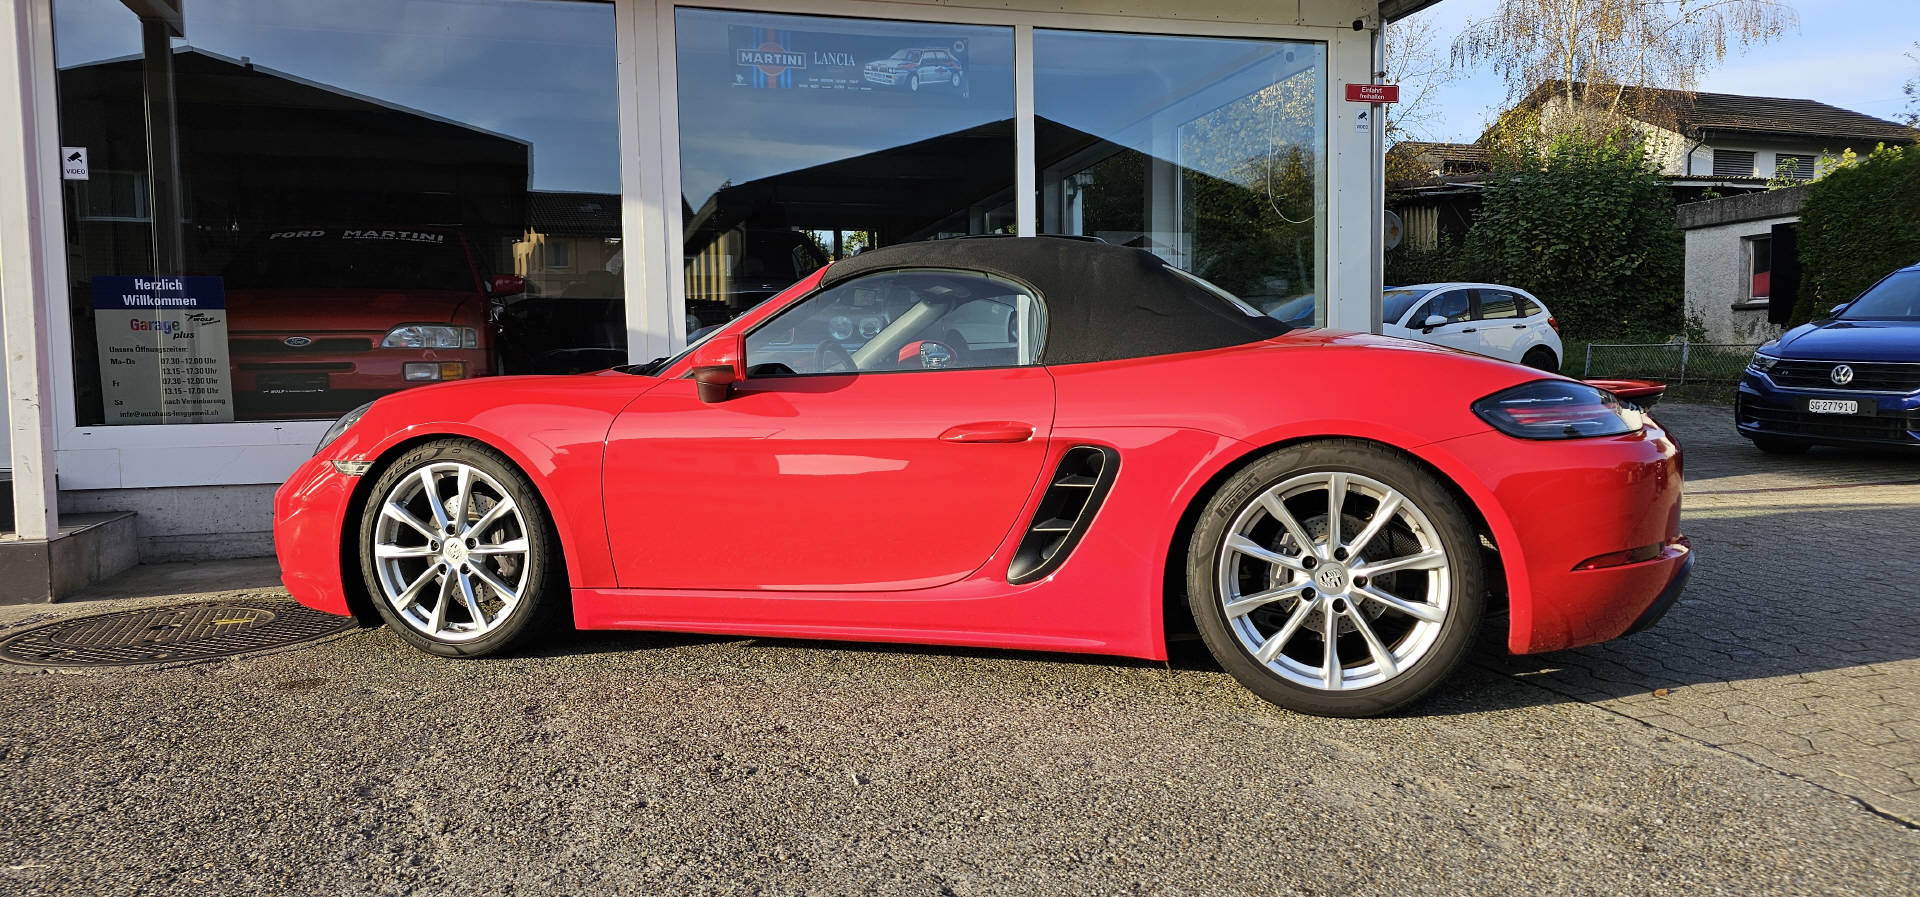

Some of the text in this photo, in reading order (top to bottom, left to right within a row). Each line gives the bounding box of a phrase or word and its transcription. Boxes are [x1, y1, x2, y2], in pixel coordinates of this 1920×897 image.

[741, 51, 856, 67] MARTINI LANCIA
[269, 230, 326, 240] FORD
[343, 230, 445, 242] MARTINI
[134, 278, 183, 291] Herzlich
[122, 294, 197, 306] Willkommen
[130, 318, 180, 335] Garage
[172, 331, 195, 340] plus
[204, 367, 217, 375] Uhr
[205, 377, 218, 385] Uhr
[207, 387, 219, 395] Uhr
[1822, 401, 1848, 412] 27791
[1215, 472, 1261, 518] PIRELLI
